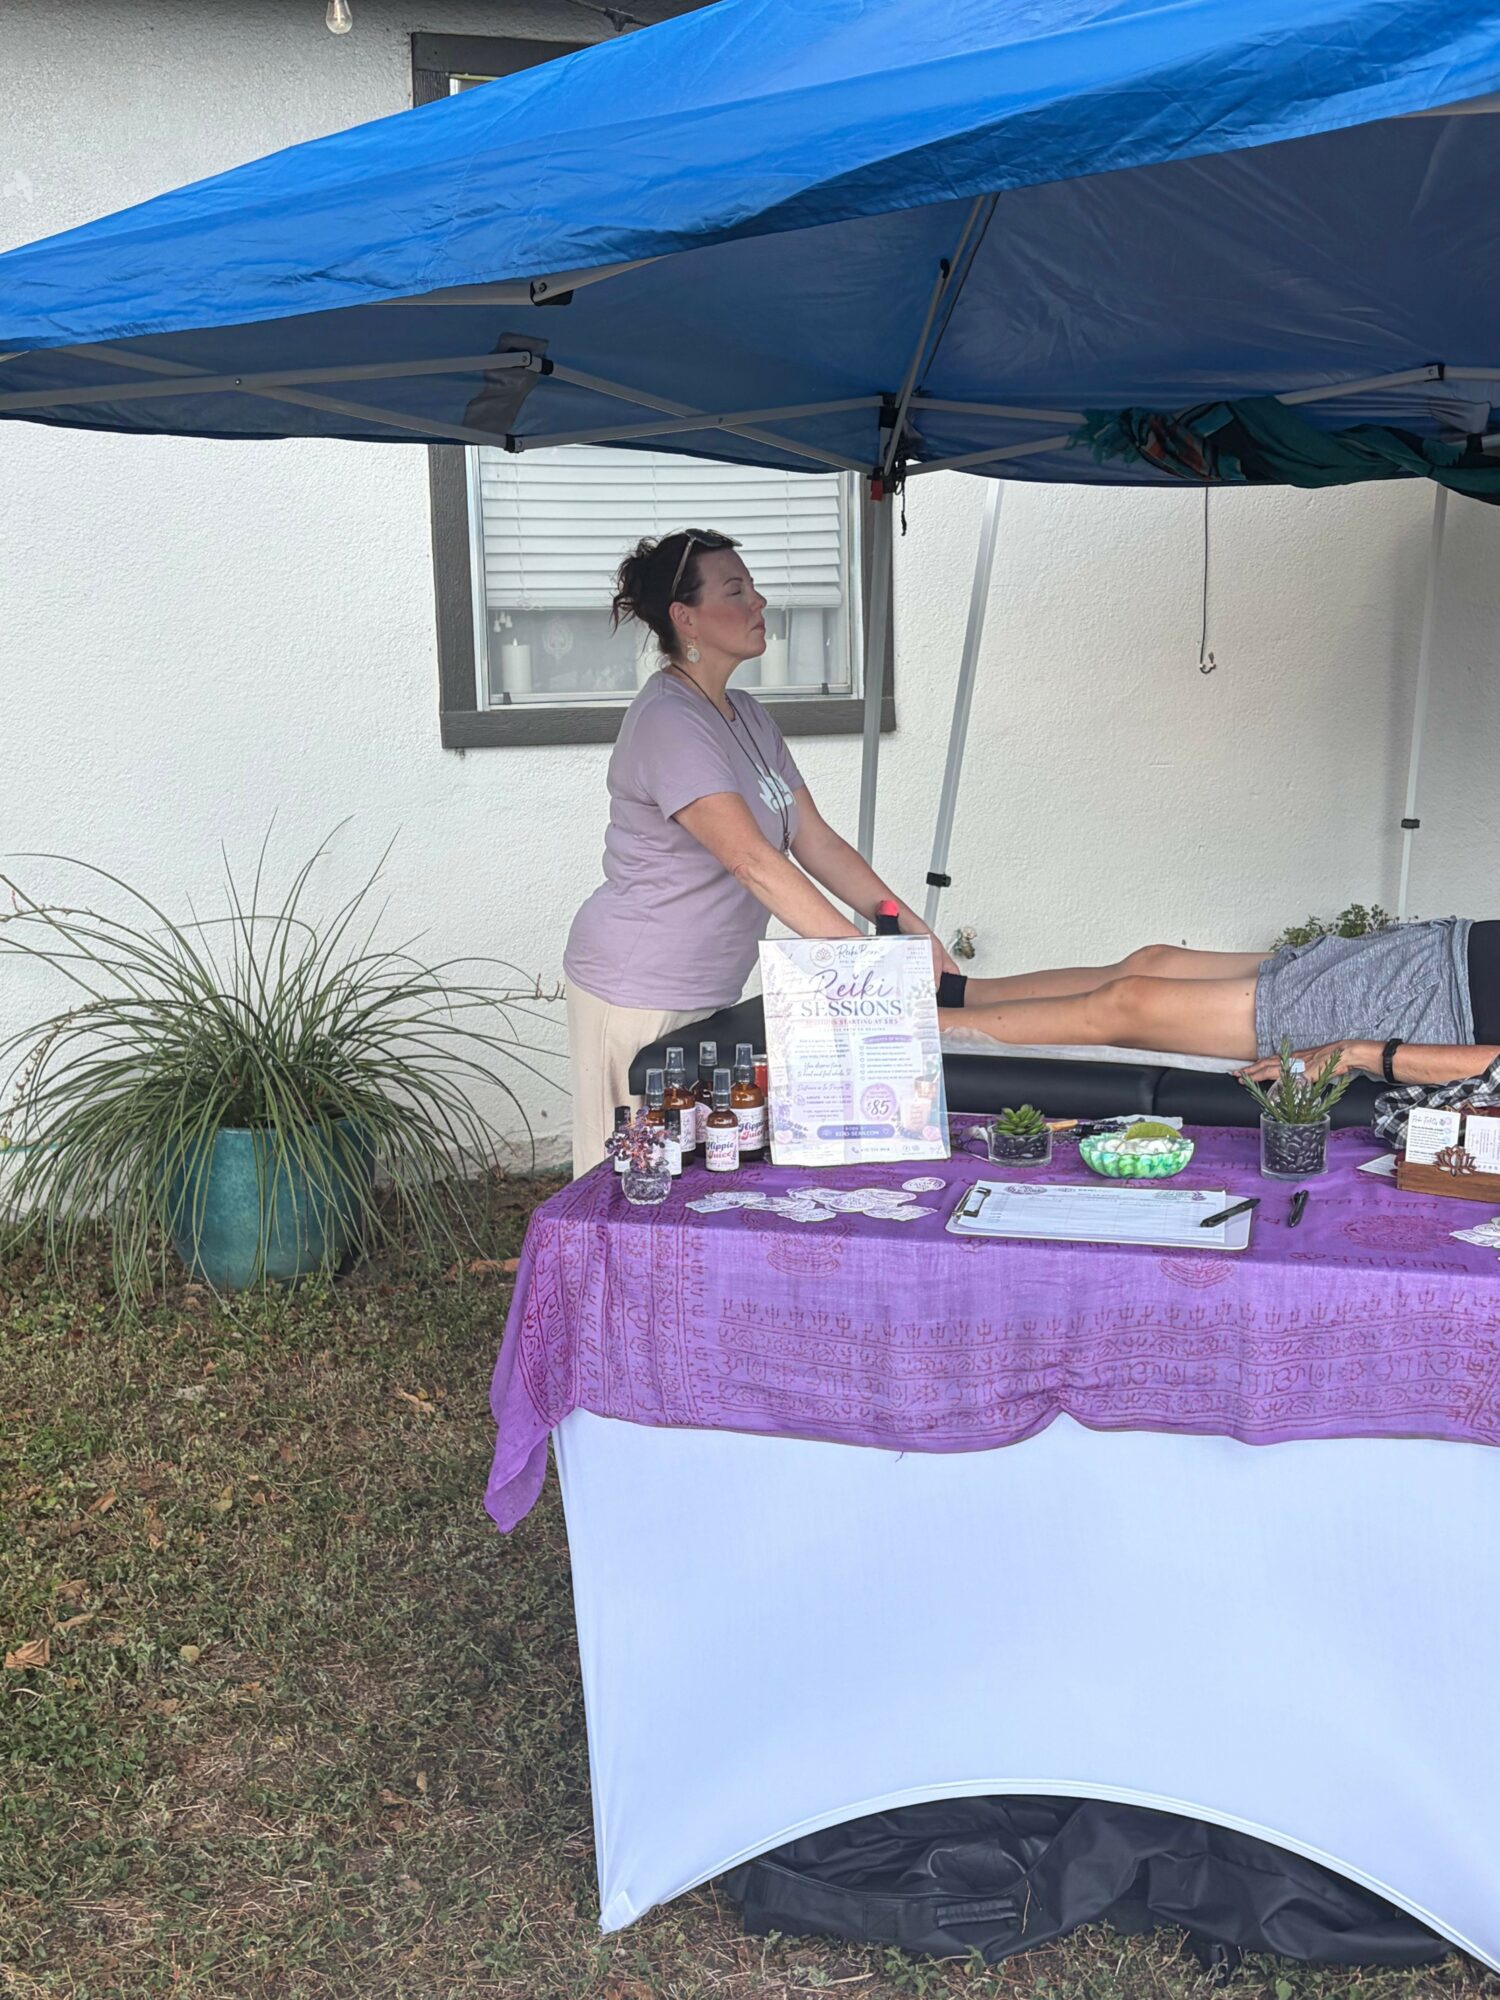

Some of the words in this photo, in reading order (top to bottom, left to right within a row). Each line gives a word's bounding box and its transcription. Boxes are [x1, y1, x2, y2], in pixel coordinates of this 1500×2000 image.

[809, 969, 893, 1000] Reiki
[801, 1000, 901, 1017] SESSIONS
[706, 1142, 733, 1151] Hippie
[708, 1151, 731, 1159] Juice
